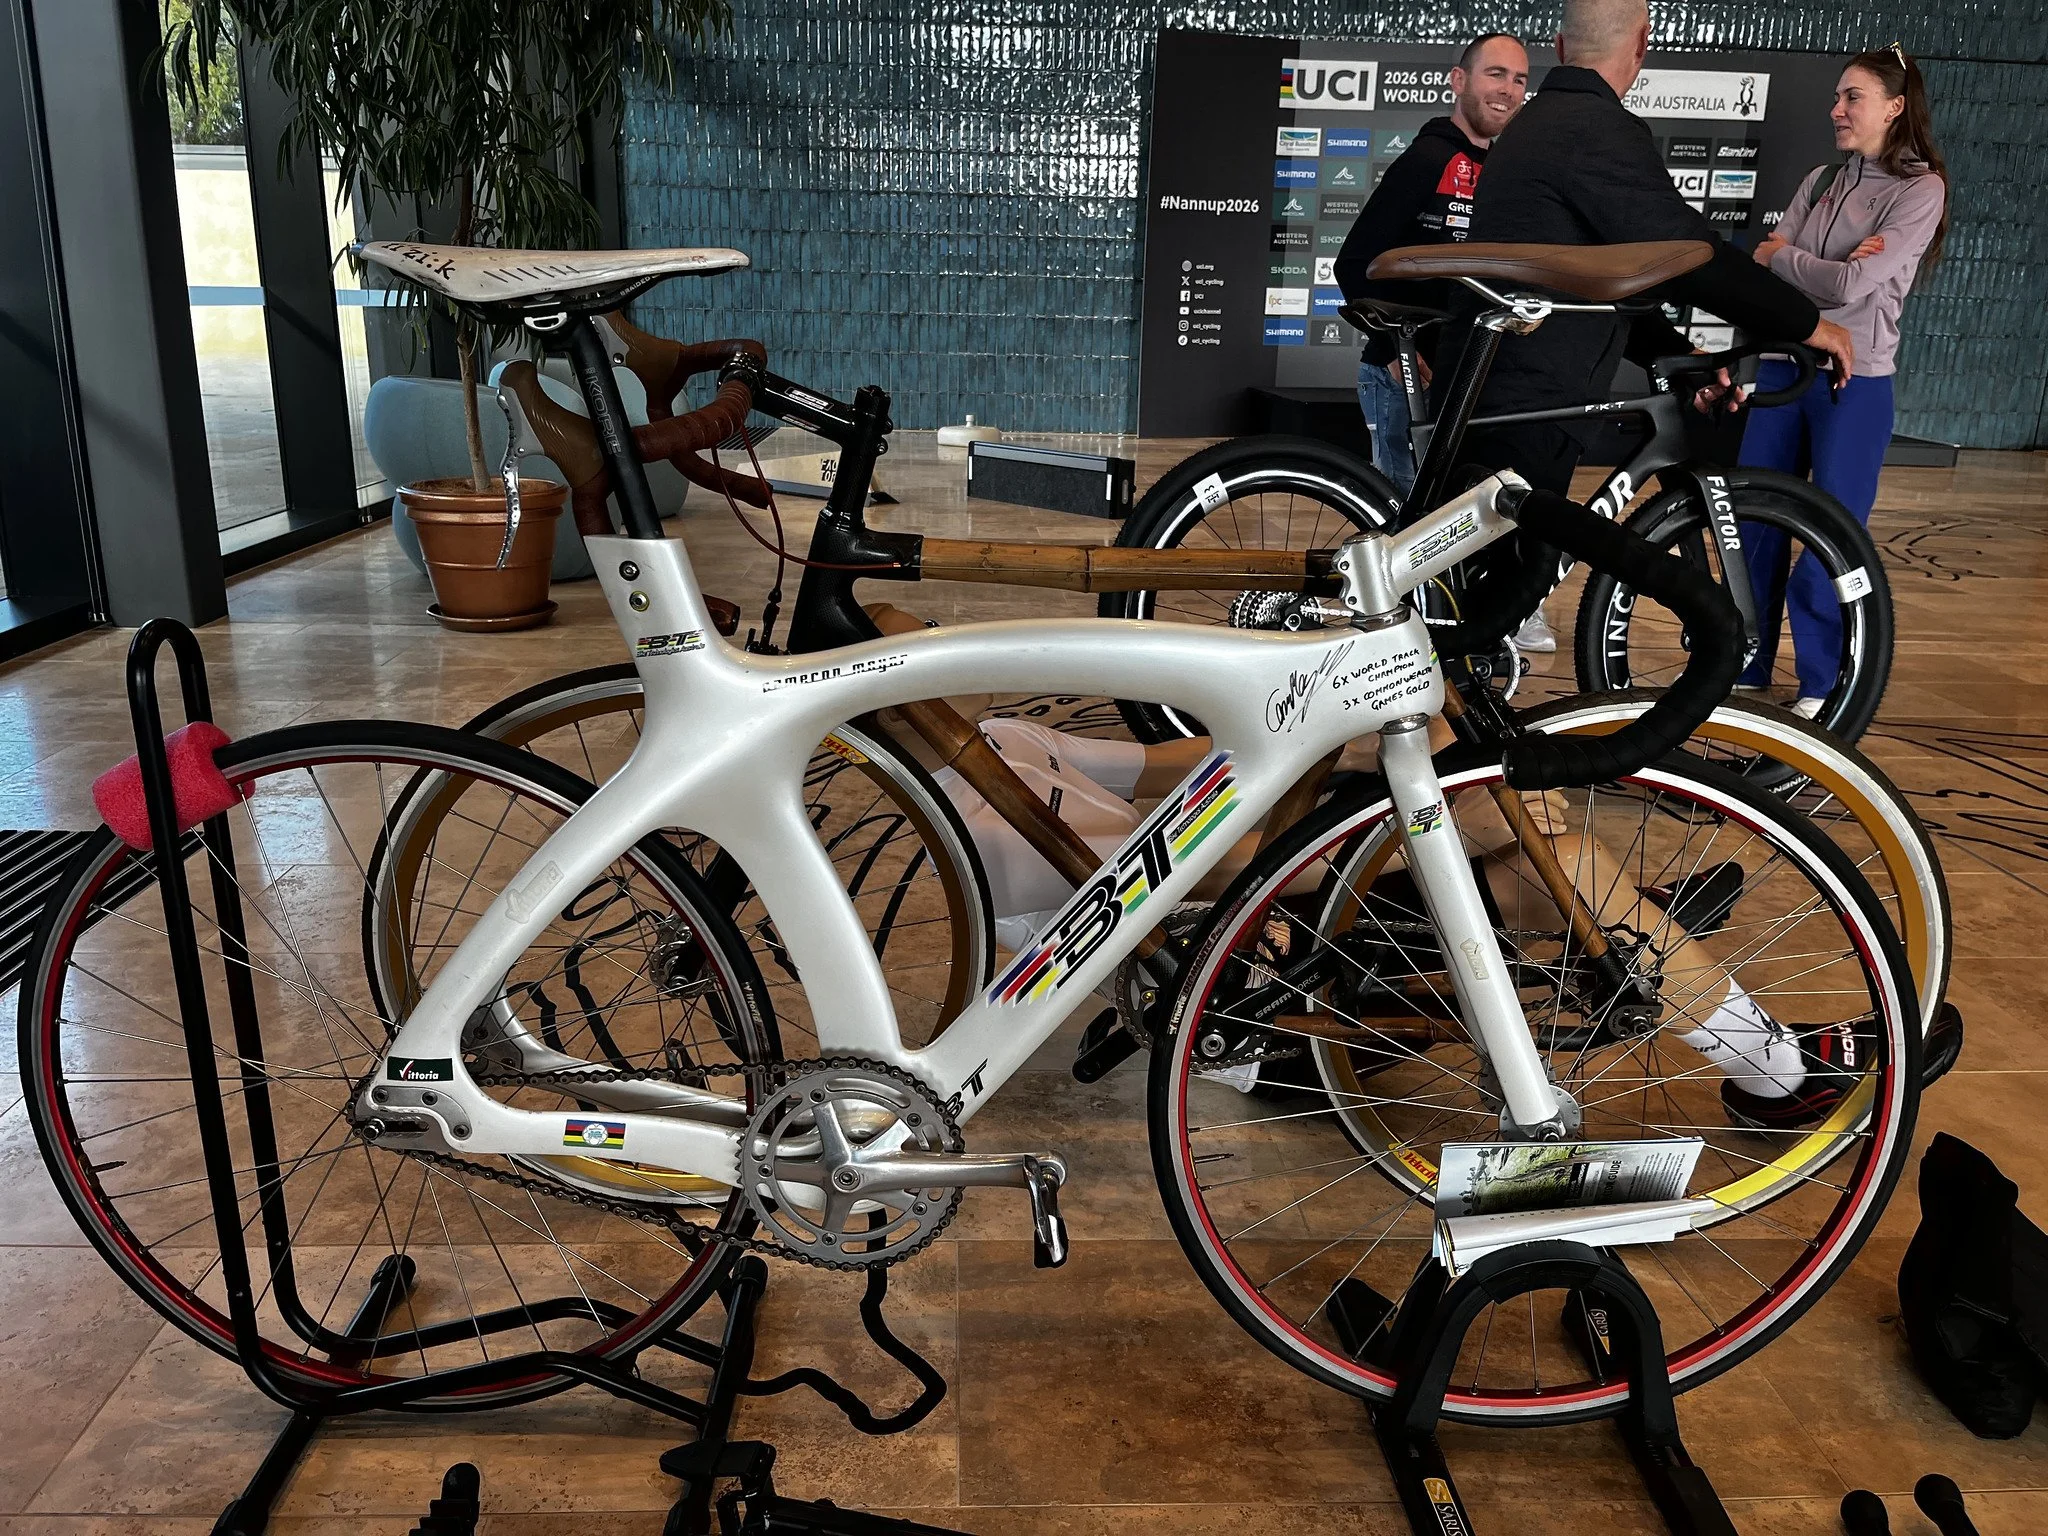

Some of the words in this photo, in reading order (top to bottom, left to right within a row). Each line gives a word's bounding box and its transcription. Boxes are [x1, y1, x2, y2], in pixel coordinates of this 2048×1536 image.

[1296, 69, 1369, 102] UCI
[1384, 71, 1418, 85] 2026
[1383, 89, 1438, 103] WORLD
[1652, 96, 1726, 111] AUSTRALIA
[1327, 139, 1368, 147] SHIMANO
[1717, 146, 1758, 157] Santini
[1277, 170, 1316, 179] SHIMANO
[1672, 176, 1703, 191] UCI
[1160, 195, 1260, 216] #Nannup2026
[1710, 211, 1748, 220] FACTOR
[1270, 266, 1308, 275] SKODA
[620, 275, 651, 296] BRAIDED
[1400, 353, 1415, 395] FACTOR
[1706, 476, 1741, 551] FACTOR
[1608, 591, 1635, 658] INC
[1350, 659, 1388, 678] WORLD
[1391, 648, 1420, 663] TRACK
[1368, 661, 1415, 682] CHAMPION
[1363, 666, 1433, 701] COMMONWEALTH
[1371, 690, 1404, 711] GAMES
[1405, 680, 1430, 696] GOLD
[1255, 991, 1292, 1020] SRAM
[399, 1060, 439, 1082] Vittoria
[1608, 1159, 1623, 1181] GUIDE
